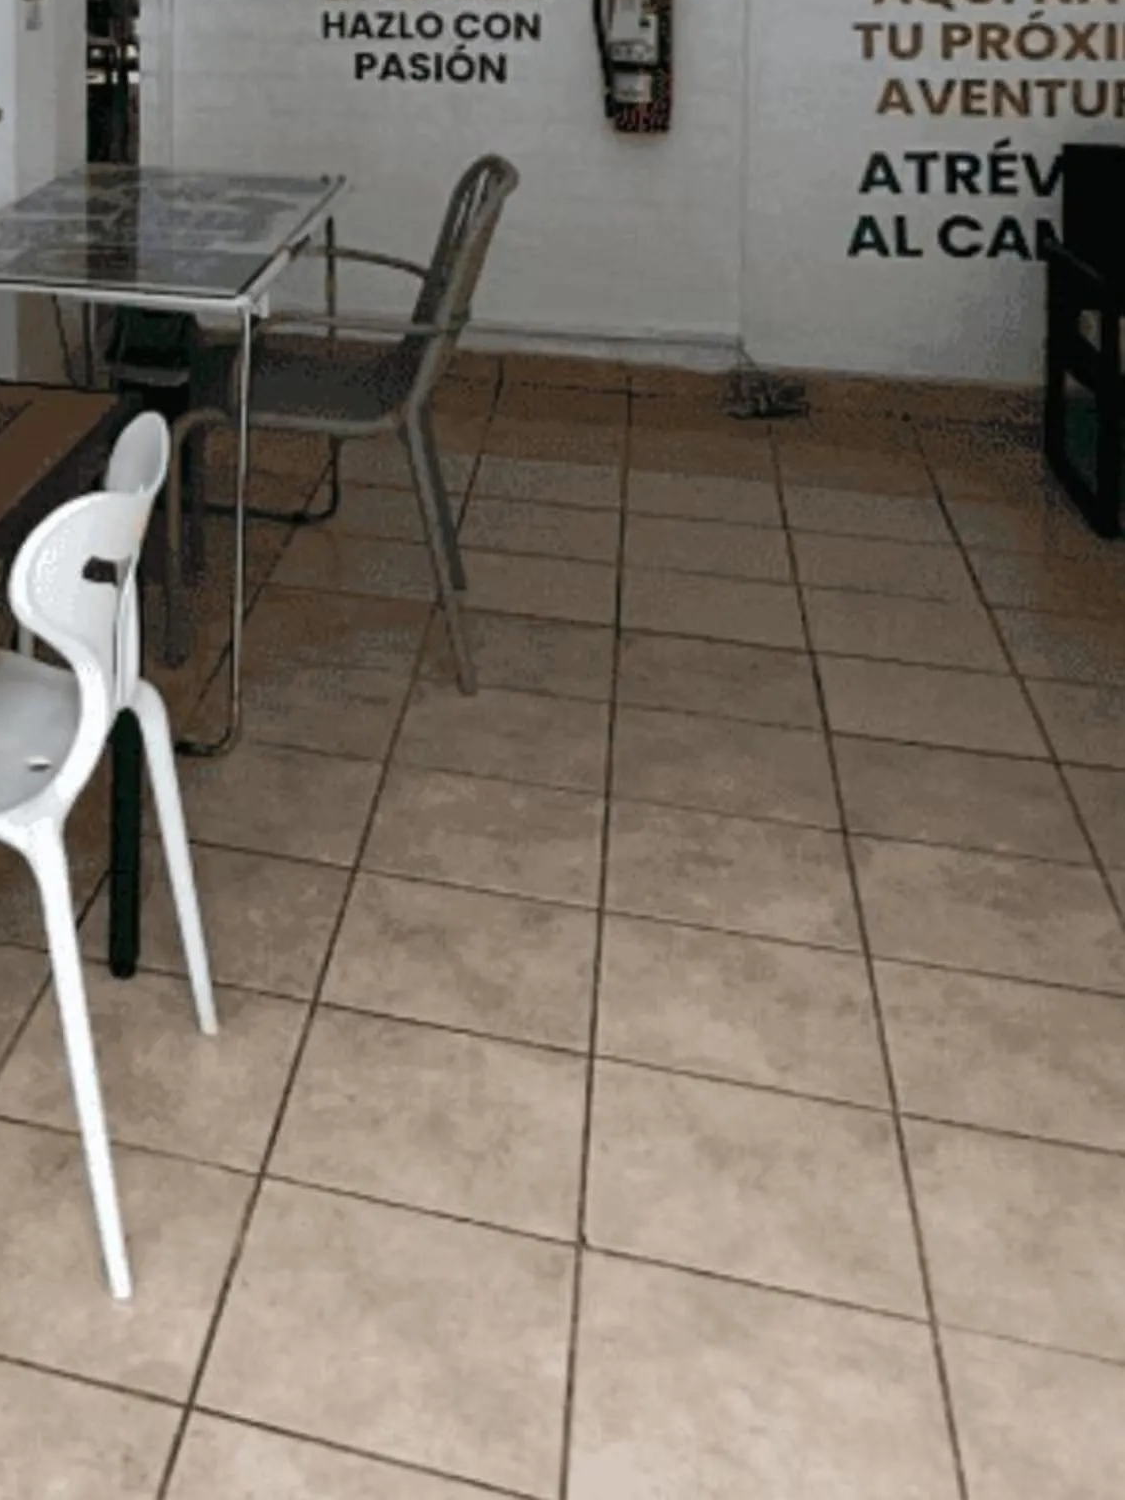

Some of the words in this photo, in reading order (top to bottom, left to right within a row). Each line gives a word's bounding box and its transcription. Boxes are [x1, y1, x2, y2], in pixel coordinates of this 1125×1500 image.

[322, 11, 443, 40] HAZLO
[453, 12, 542, 41] CON
[852, 22, 924, 61] TU
[941, 10, 1125, 62] PRÓXI
[354, 43, 508, 84] PASIÓN
[847, 215, 924, 258] AL
